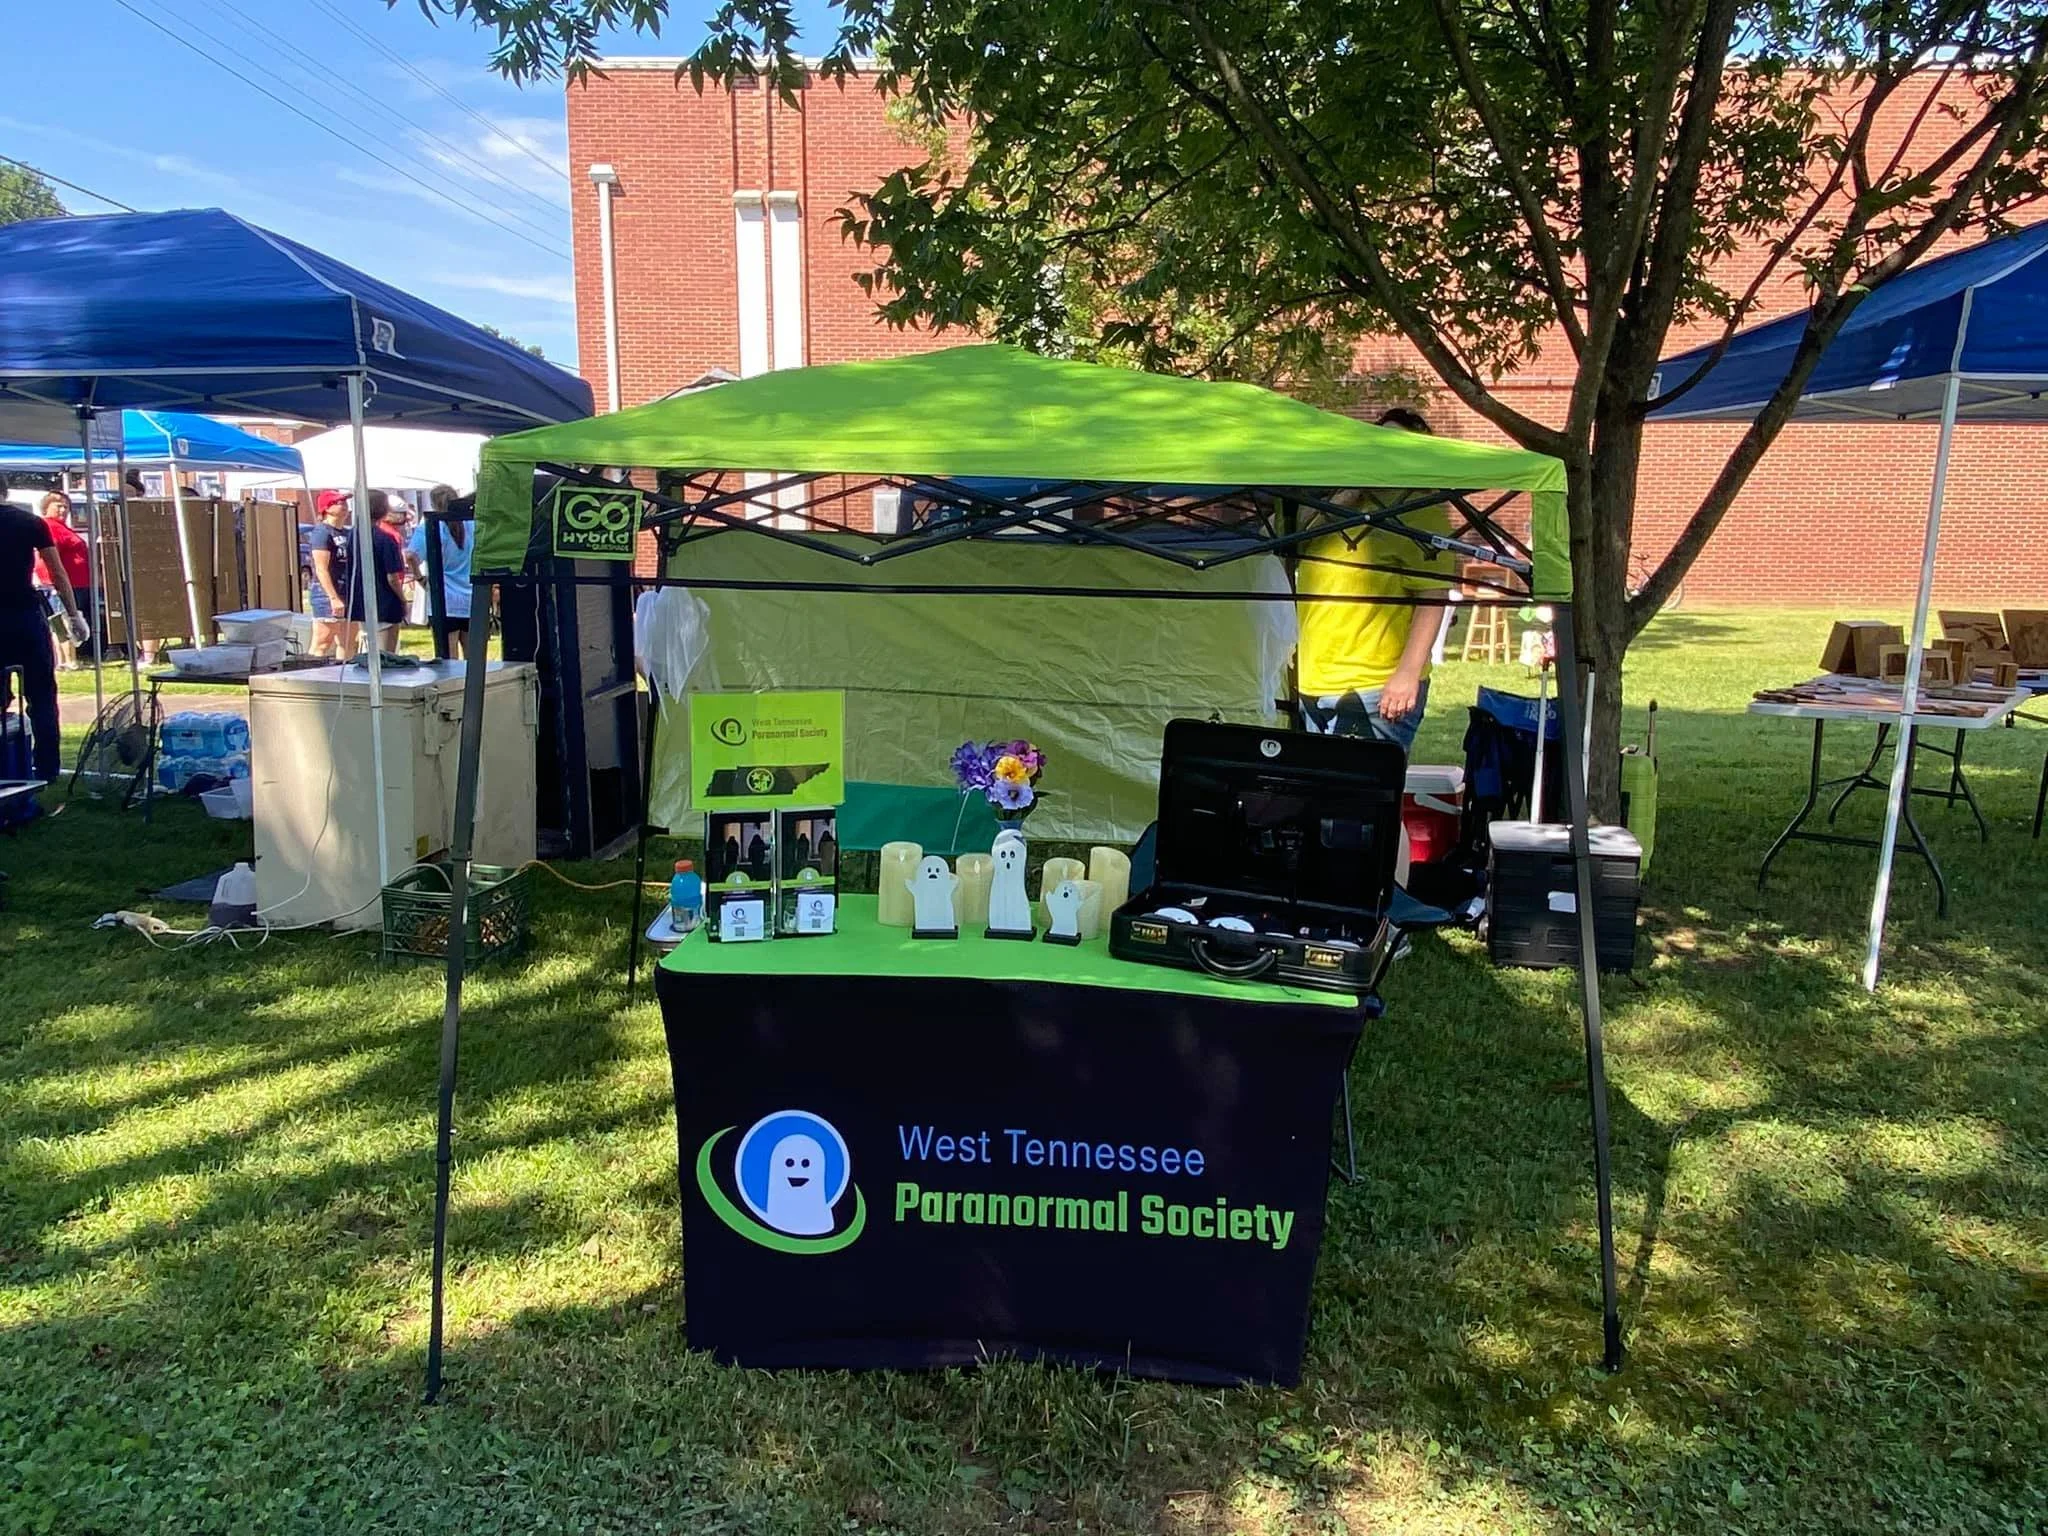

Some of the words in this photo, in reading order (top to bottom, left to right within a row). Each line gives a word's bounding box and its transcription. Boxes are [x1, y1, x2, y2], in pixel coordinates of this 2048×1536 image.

[565, 494, 630, 530] GO
[899, 1125, 991, 1162] West
[1003, 1129, 1205, 1175] Tennessee
[895, 1182, 1128, 1232] Paranormal
[1141, 1194, 1295, 1249] Society
